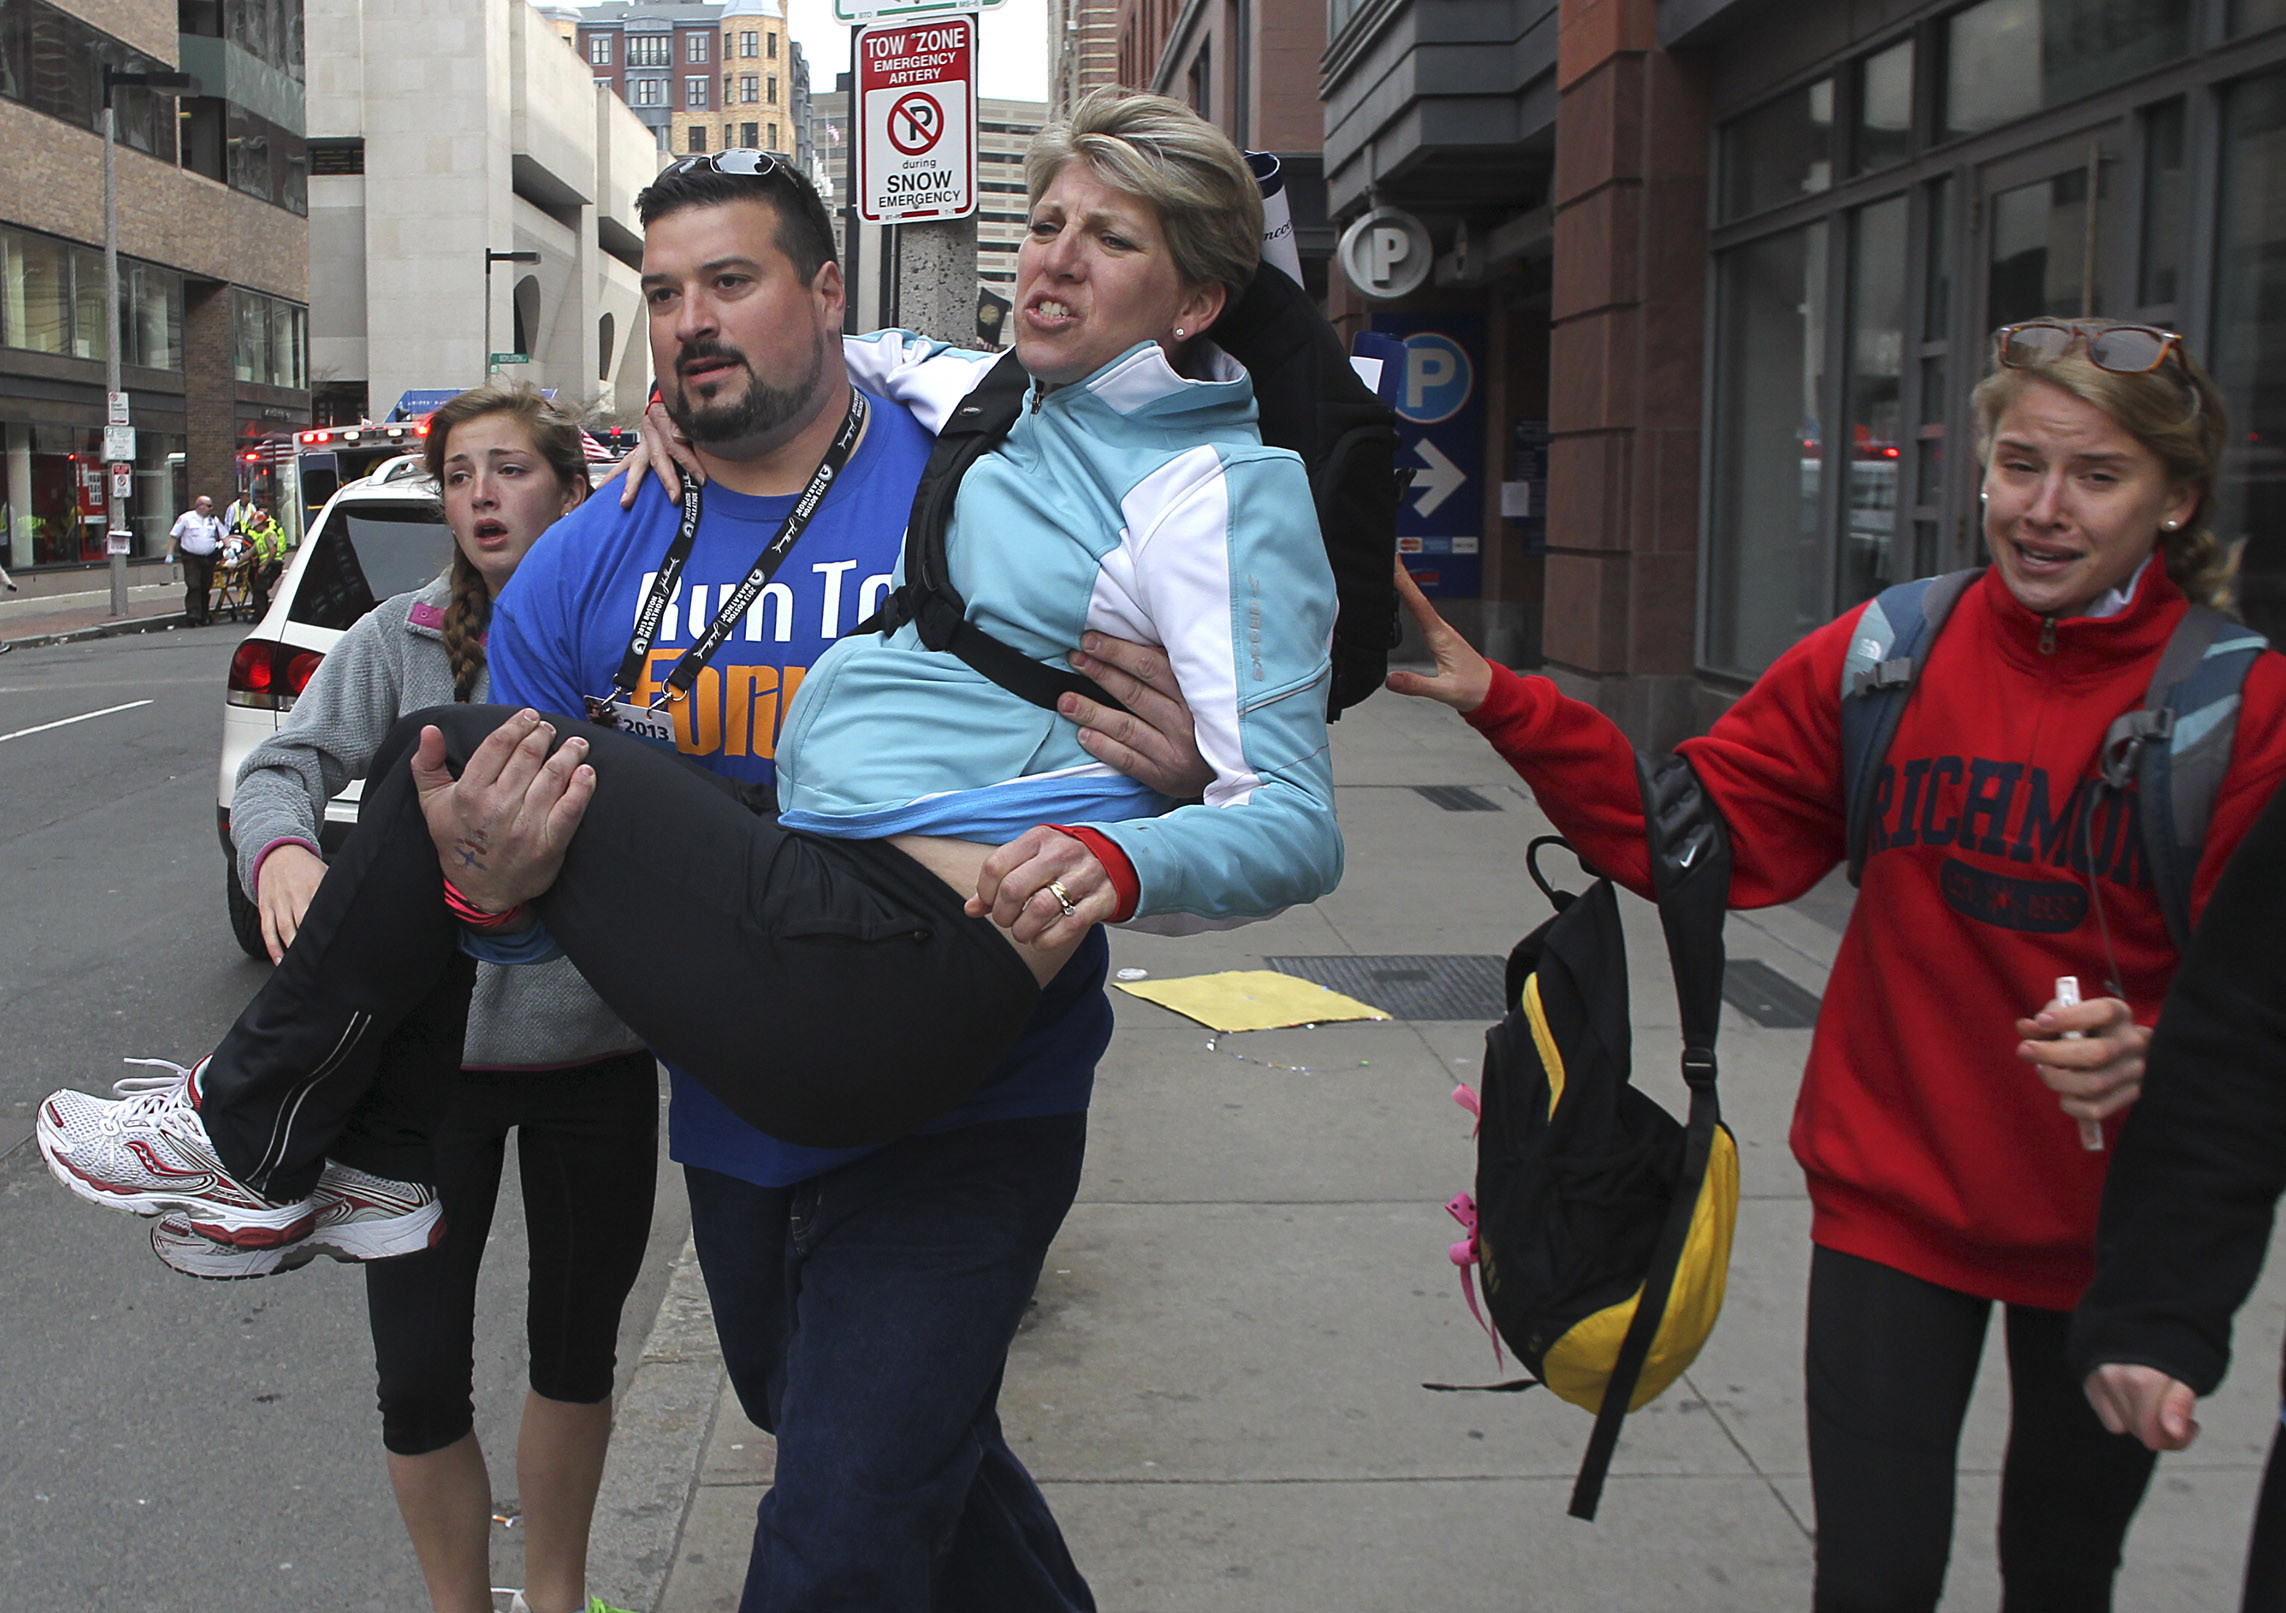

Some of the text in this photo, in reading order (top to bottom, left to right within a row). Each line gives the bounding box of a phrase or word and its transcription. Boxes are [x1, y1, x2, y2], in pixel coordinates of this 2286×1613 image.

[866, 27, 965, 58] TOW ZONE
[874, 52, 956, 72] EMERGENCY
[888, 67, 941, 85] ARTERY
[887, 170, 952, 193] SNOW
[902, 159, 937, 169] during
[879, 190, 960, 208] EMERGENCY
[1372, 227, 1410, 282] P
[1406, 347, 1456, 408] P
[795, 477, 821, 517] MARATHON
[801, 481, 827, 518] 2013 BOSTON
[633, 571, 794, 642] Run
[637, 595, 658, 636] 2013 BOSTON
[643, 596, 665, 639] MARATHON
[720, 582, 751, 622] MARATHON
[726, 586, 757, 624] 2013 BOSTON
[623, 718, 670, 741] 2013
